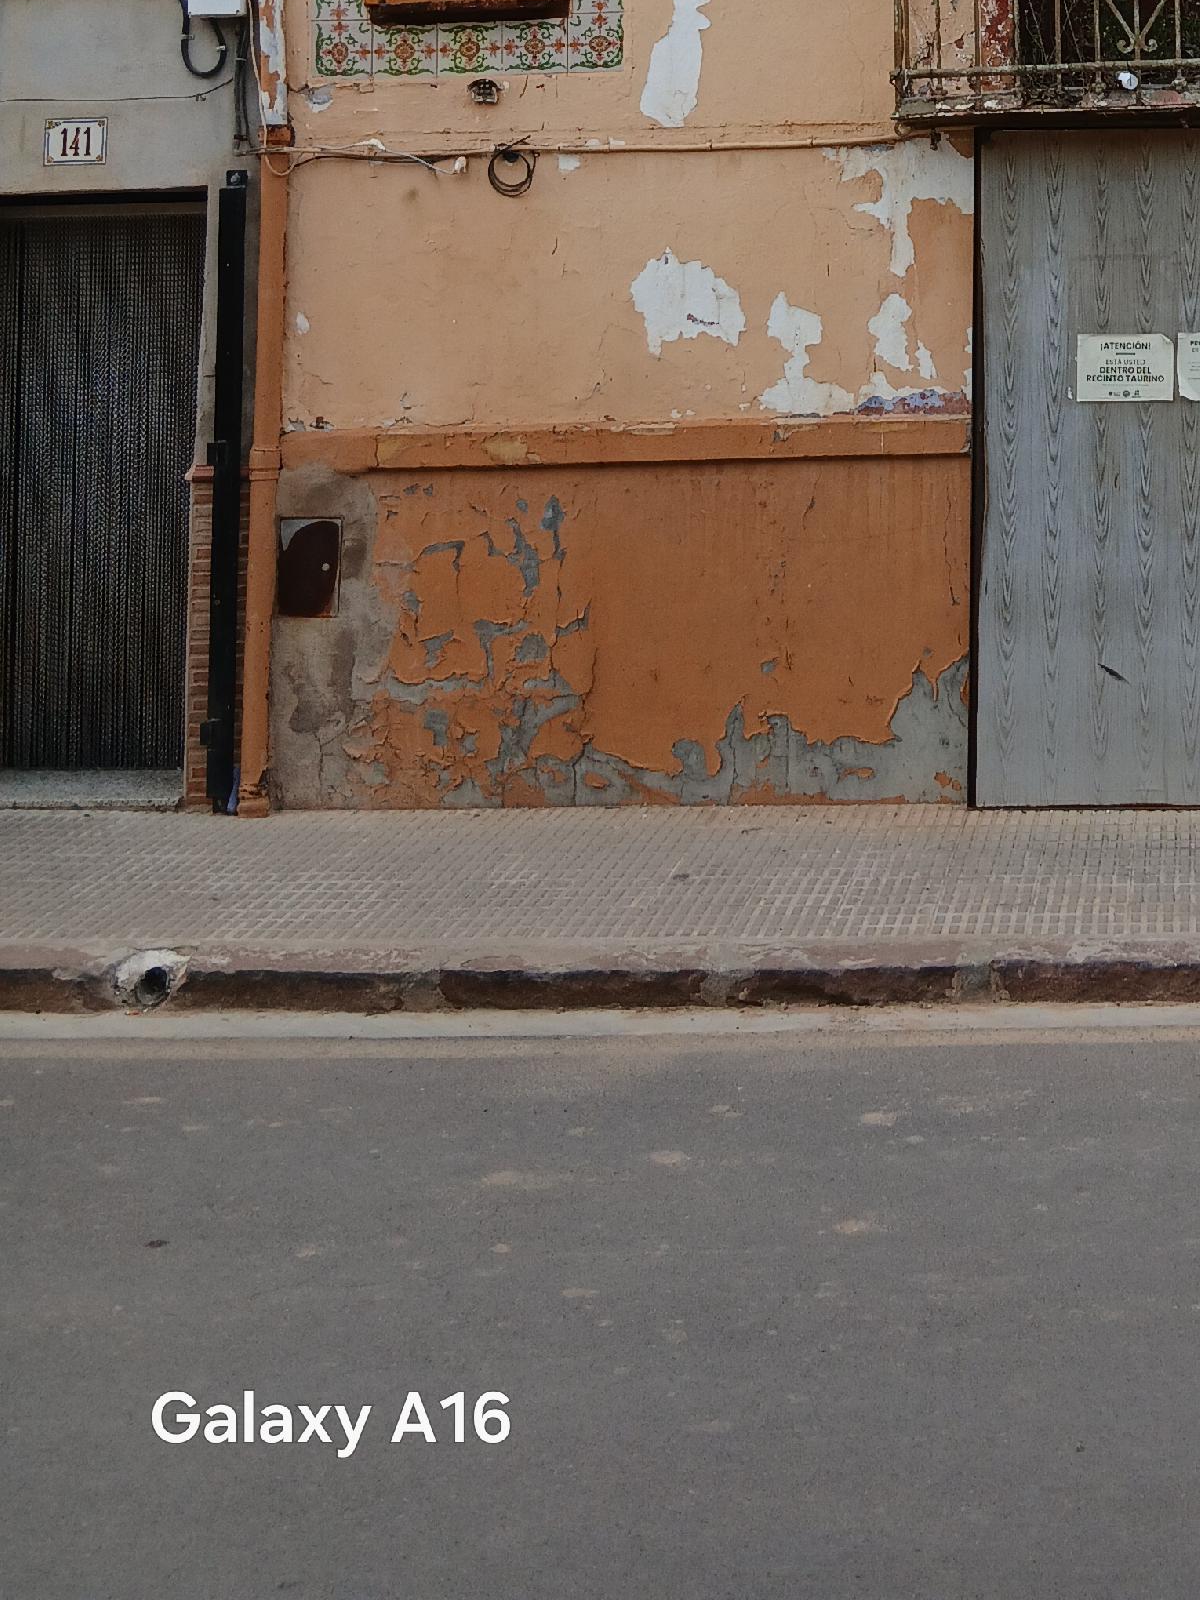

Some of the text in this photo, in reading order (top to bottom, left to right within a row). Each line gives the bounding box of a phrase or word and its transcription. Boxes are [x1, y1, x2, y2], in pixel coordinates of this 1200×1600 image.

[60, 126, 92, 157] 141
[1100, 340, 1151, 351] ¡ATENCIÓN!
[1099, 366, 1152, 375] DENTRO DEL
[1086, 374, 1165, 382] RECINTO TAURINO
